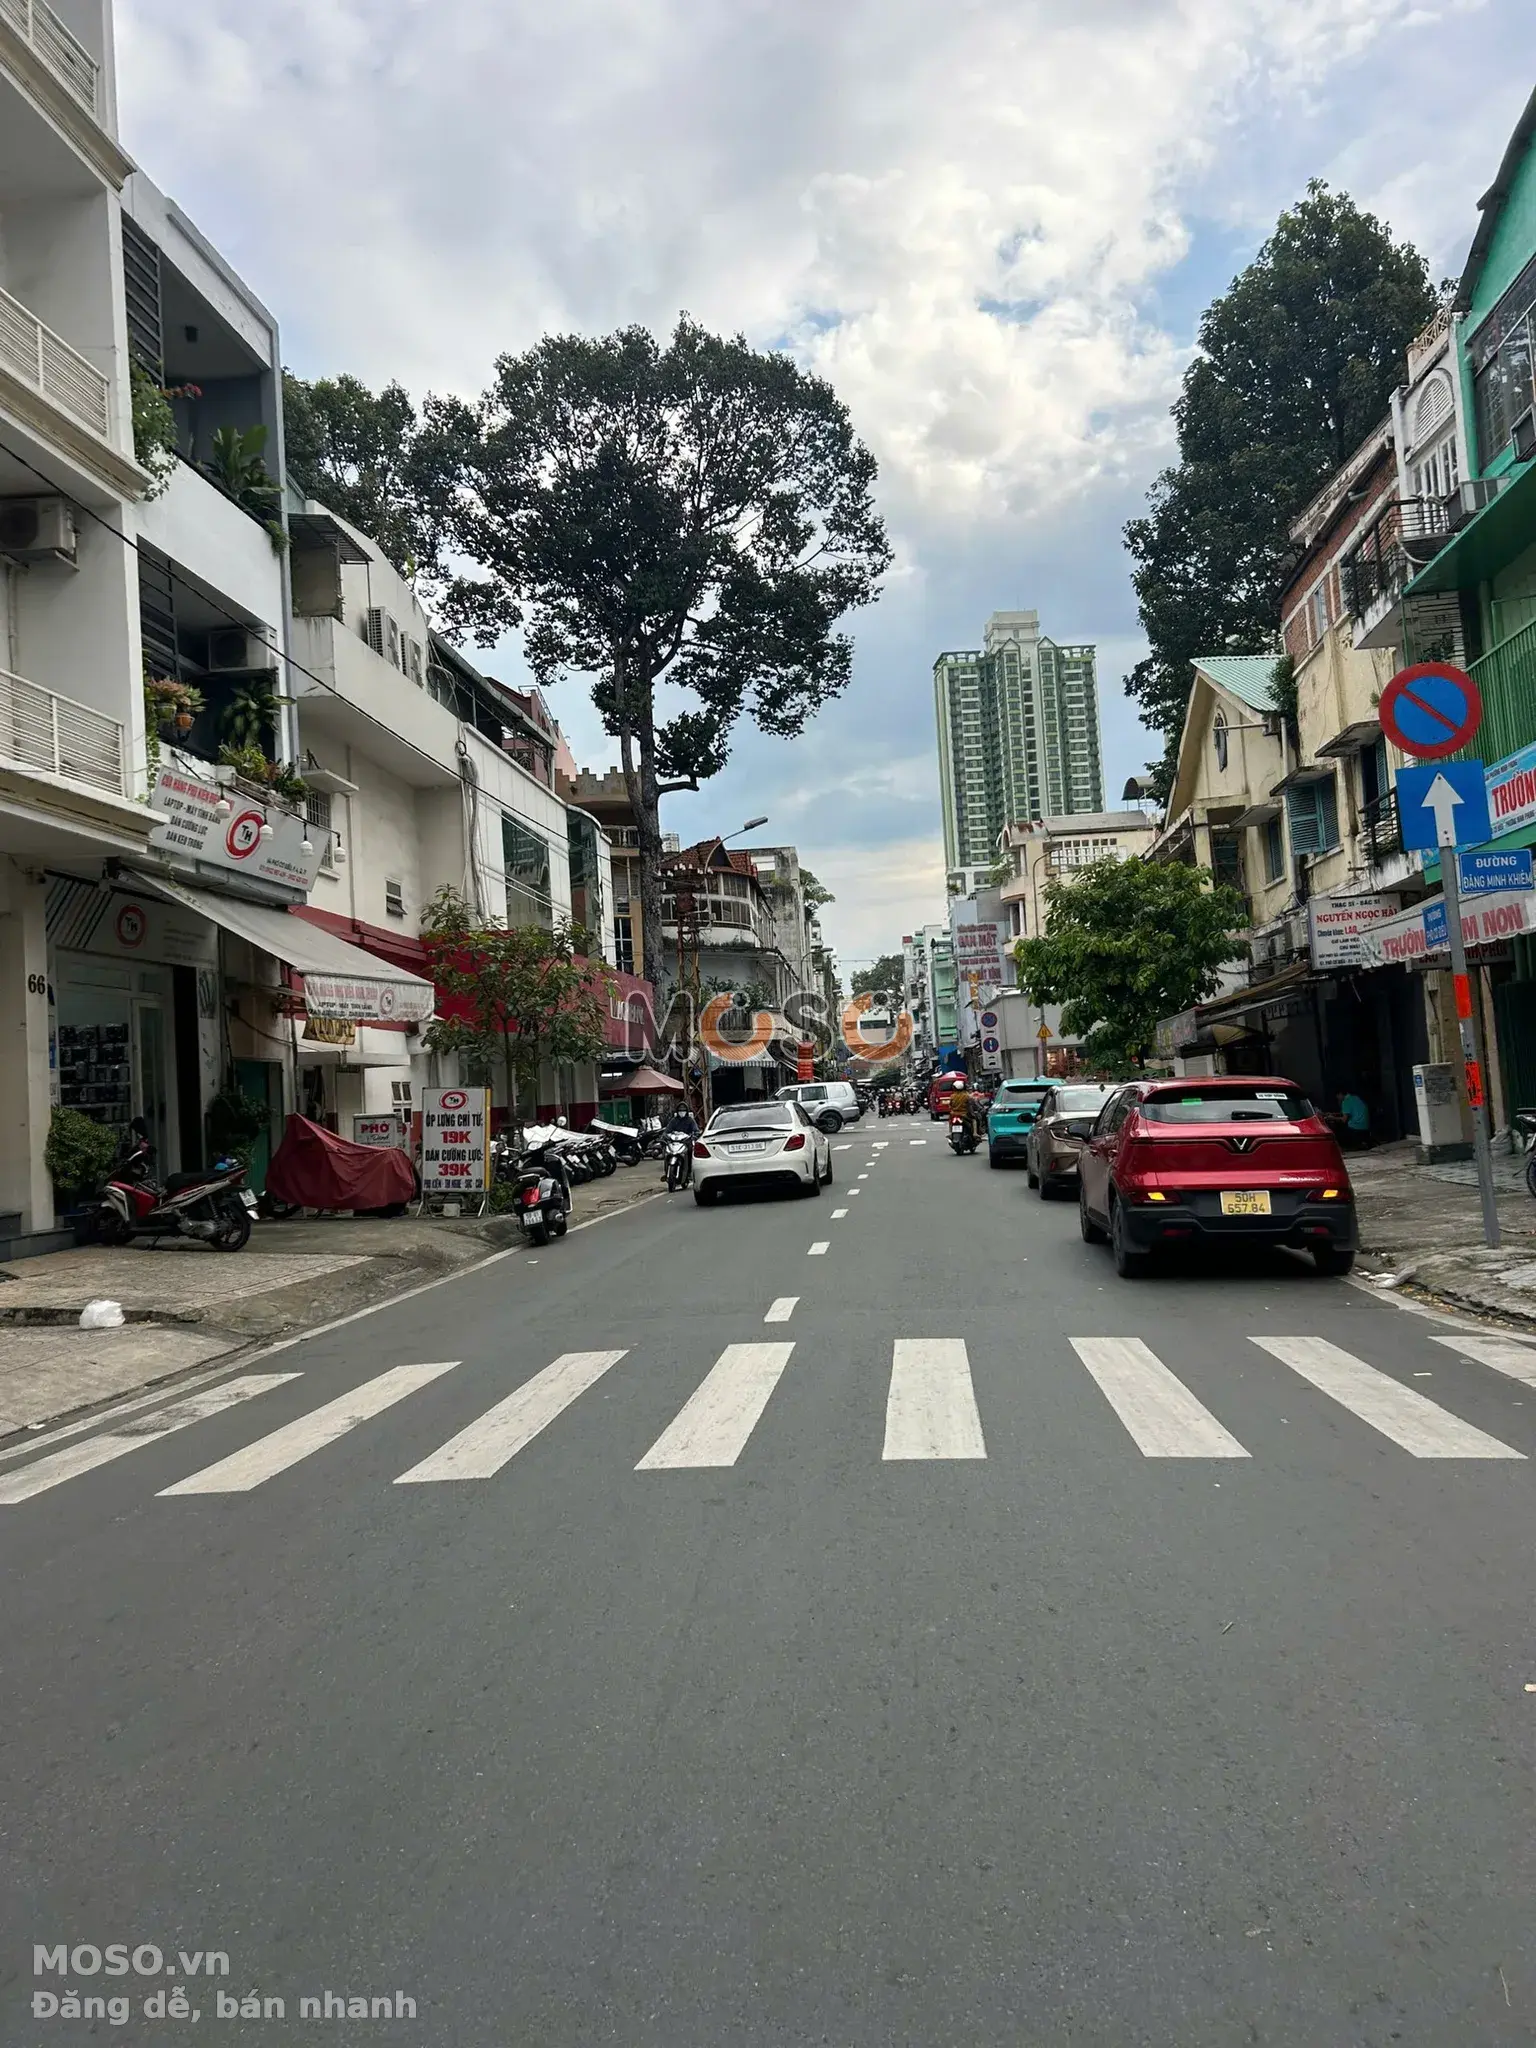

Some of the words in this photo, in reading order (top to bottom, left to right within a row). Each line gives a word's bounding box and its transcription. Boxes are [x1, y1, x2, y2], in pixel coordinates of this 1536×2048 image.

[1491, 769, 1536, 819] TRƯỜN
[163, 796, 184, 811] LAPTOP
[241, 824, 253, 842] TH
[1475, 856, 1517, 869] ĐƯỜNG
[1486, 873, 1507, 887] MINH
[1316, 908, 1354, 924] NGUYỄN
[1355, 909, 1380, 921] NGỌC
[1482, 903, 1524, 937] NON
[28, 973, 46, 995] 66
[437, 1111, 456, 1127] LƯNG
[440, 1130, 472, 1144] 19K
[425, 1147, 440, 1162] DÁN
[438, 1163, 472, 1177] 39K
[1234, 1193, 1257, 1203] 50H
